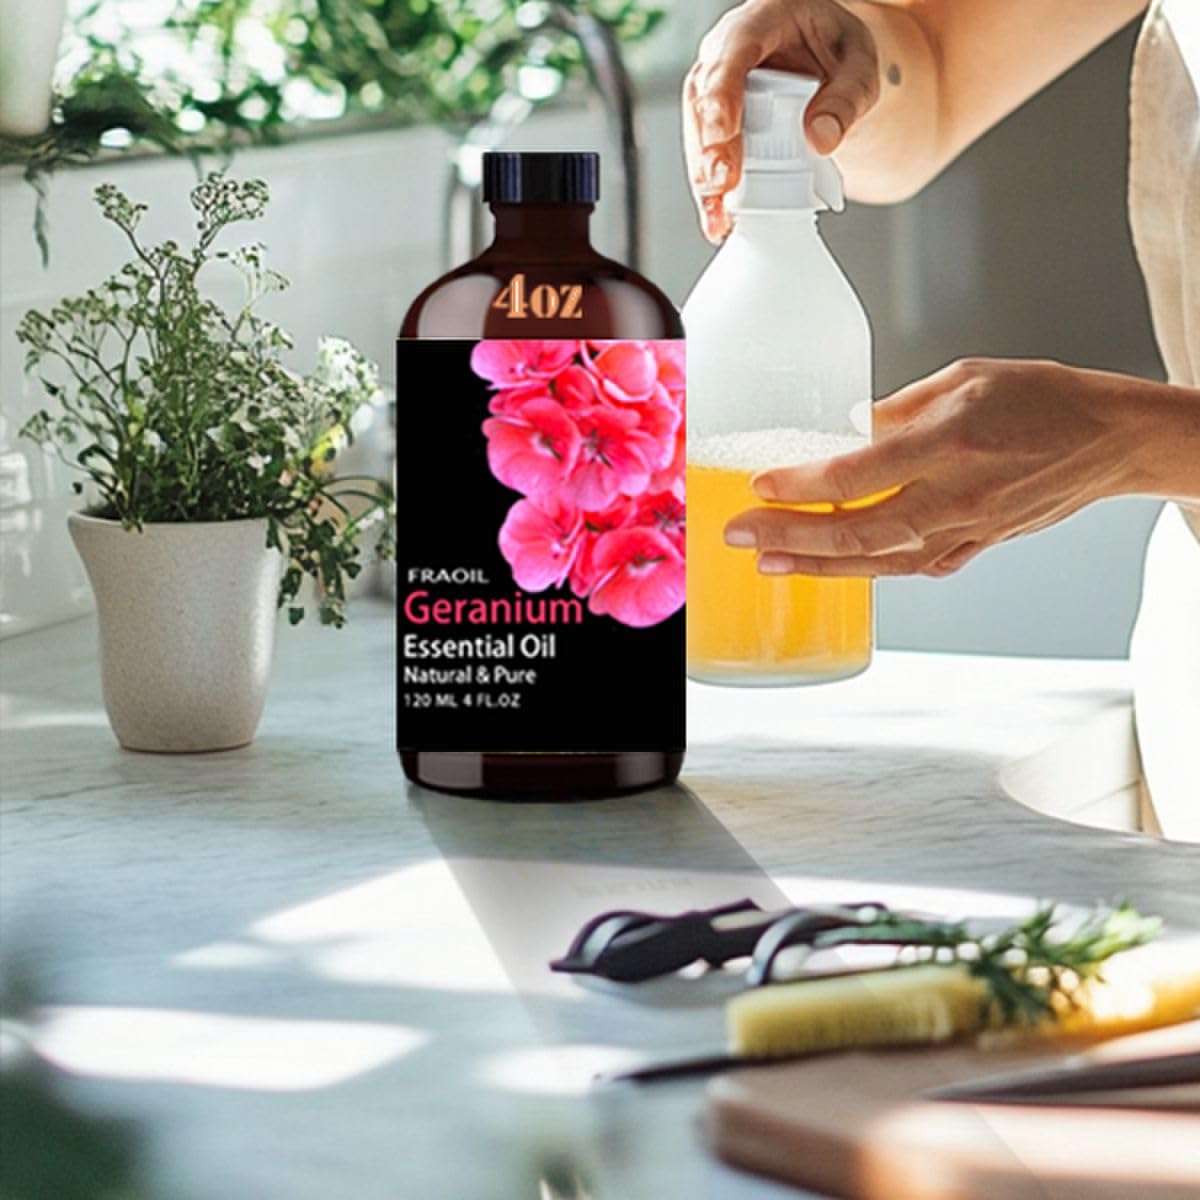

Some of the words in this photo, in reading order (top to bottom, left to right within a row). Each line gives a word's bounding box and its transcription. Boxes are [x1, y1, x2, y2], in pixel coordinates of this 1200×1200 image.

[492, 273, 583, 319] 4oz
[408, 568, 489, 584] FRAOIL
[404, 590, 583, 625] Geranium
[404, 633, 514, 658] Essential
[520, 633, 556, 659] Oil
[404, 665, 472, 684] Natural
[476, 665, 490, 684] &
[493, 665, 537, 684] Pure
[404, 693, 433, 708] 120
[435, 693, 458, 708] ML
[463, 693, 473, 707] 4
